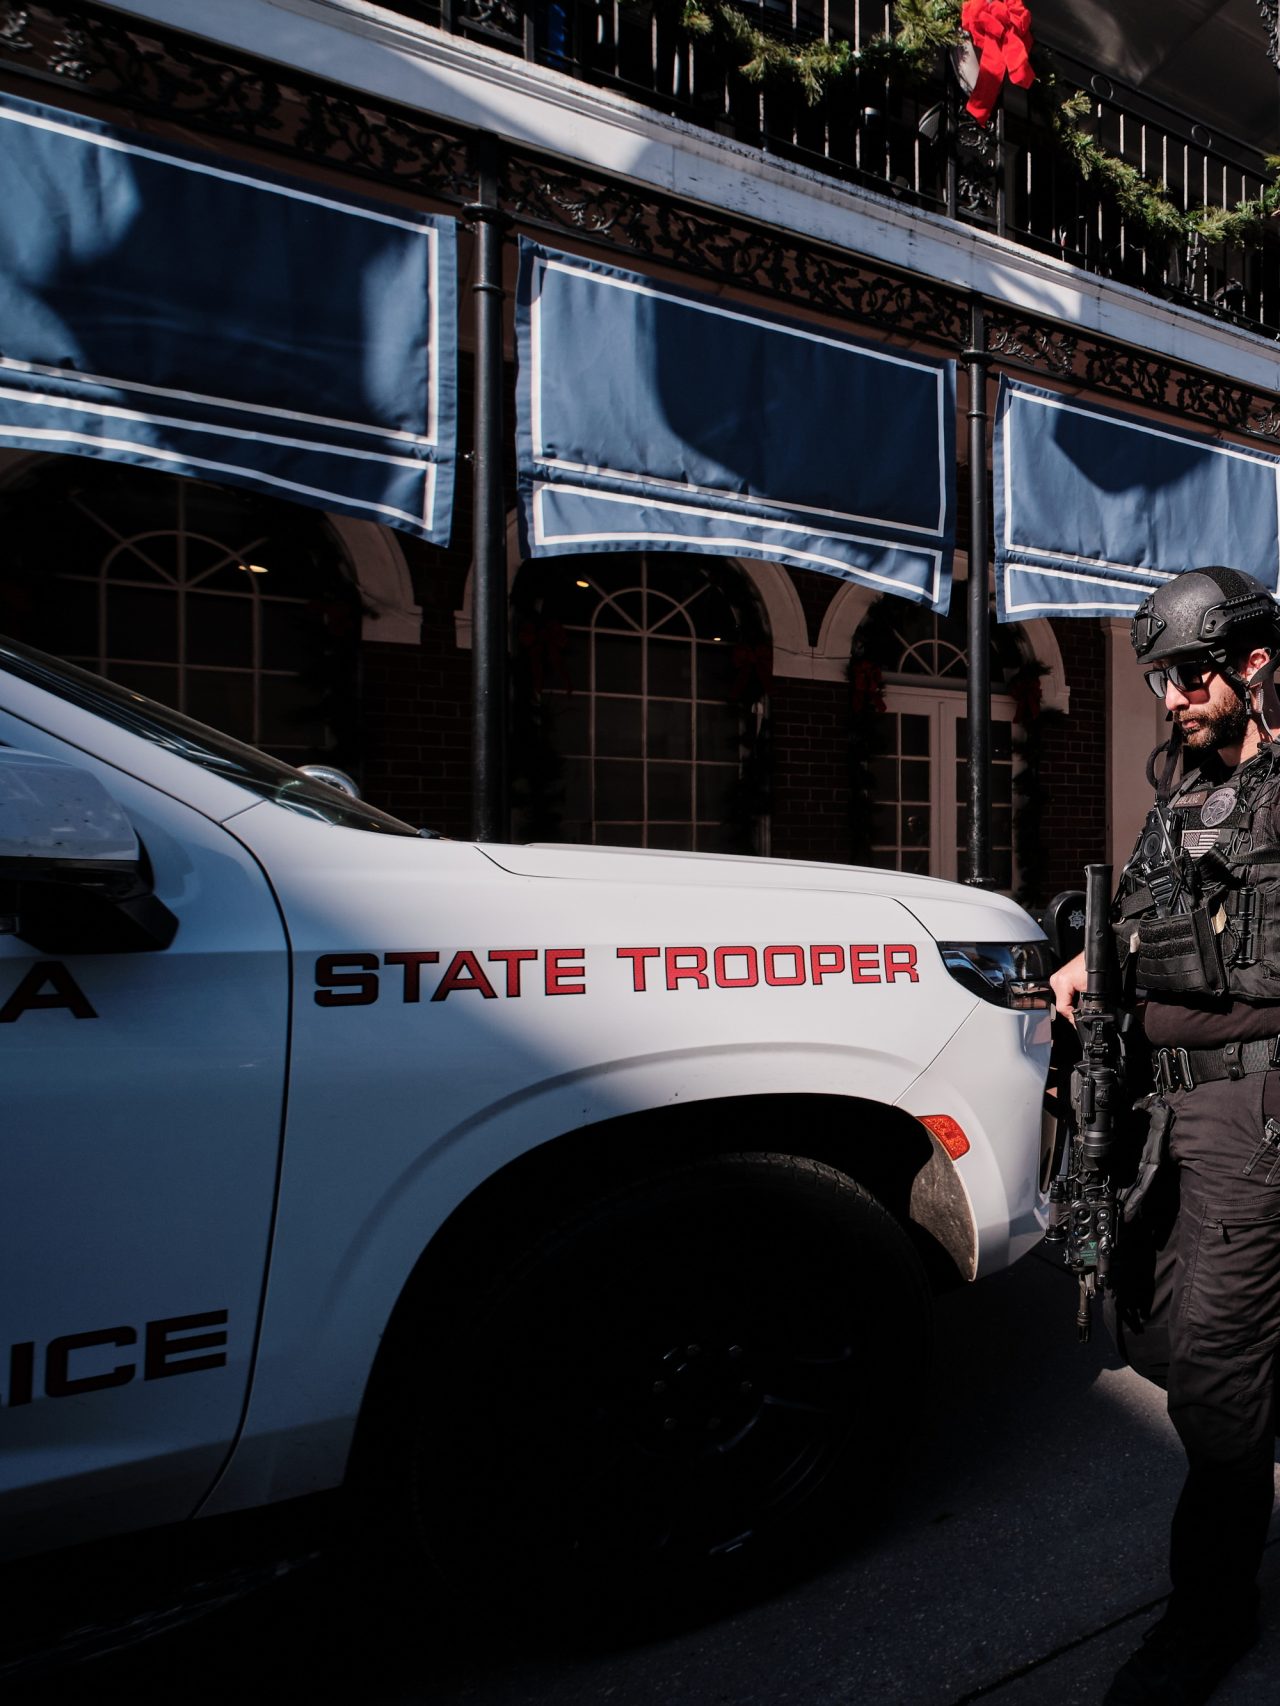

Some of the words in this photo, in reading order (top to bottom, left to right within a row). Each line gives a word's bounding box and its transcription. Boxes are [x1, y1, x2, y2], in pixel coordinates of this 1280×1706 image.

[314, 948, 587, 1007] STATE
[616, 944, 920, 992] TROOPER
[0, 1309, 228, 1408] ICE
